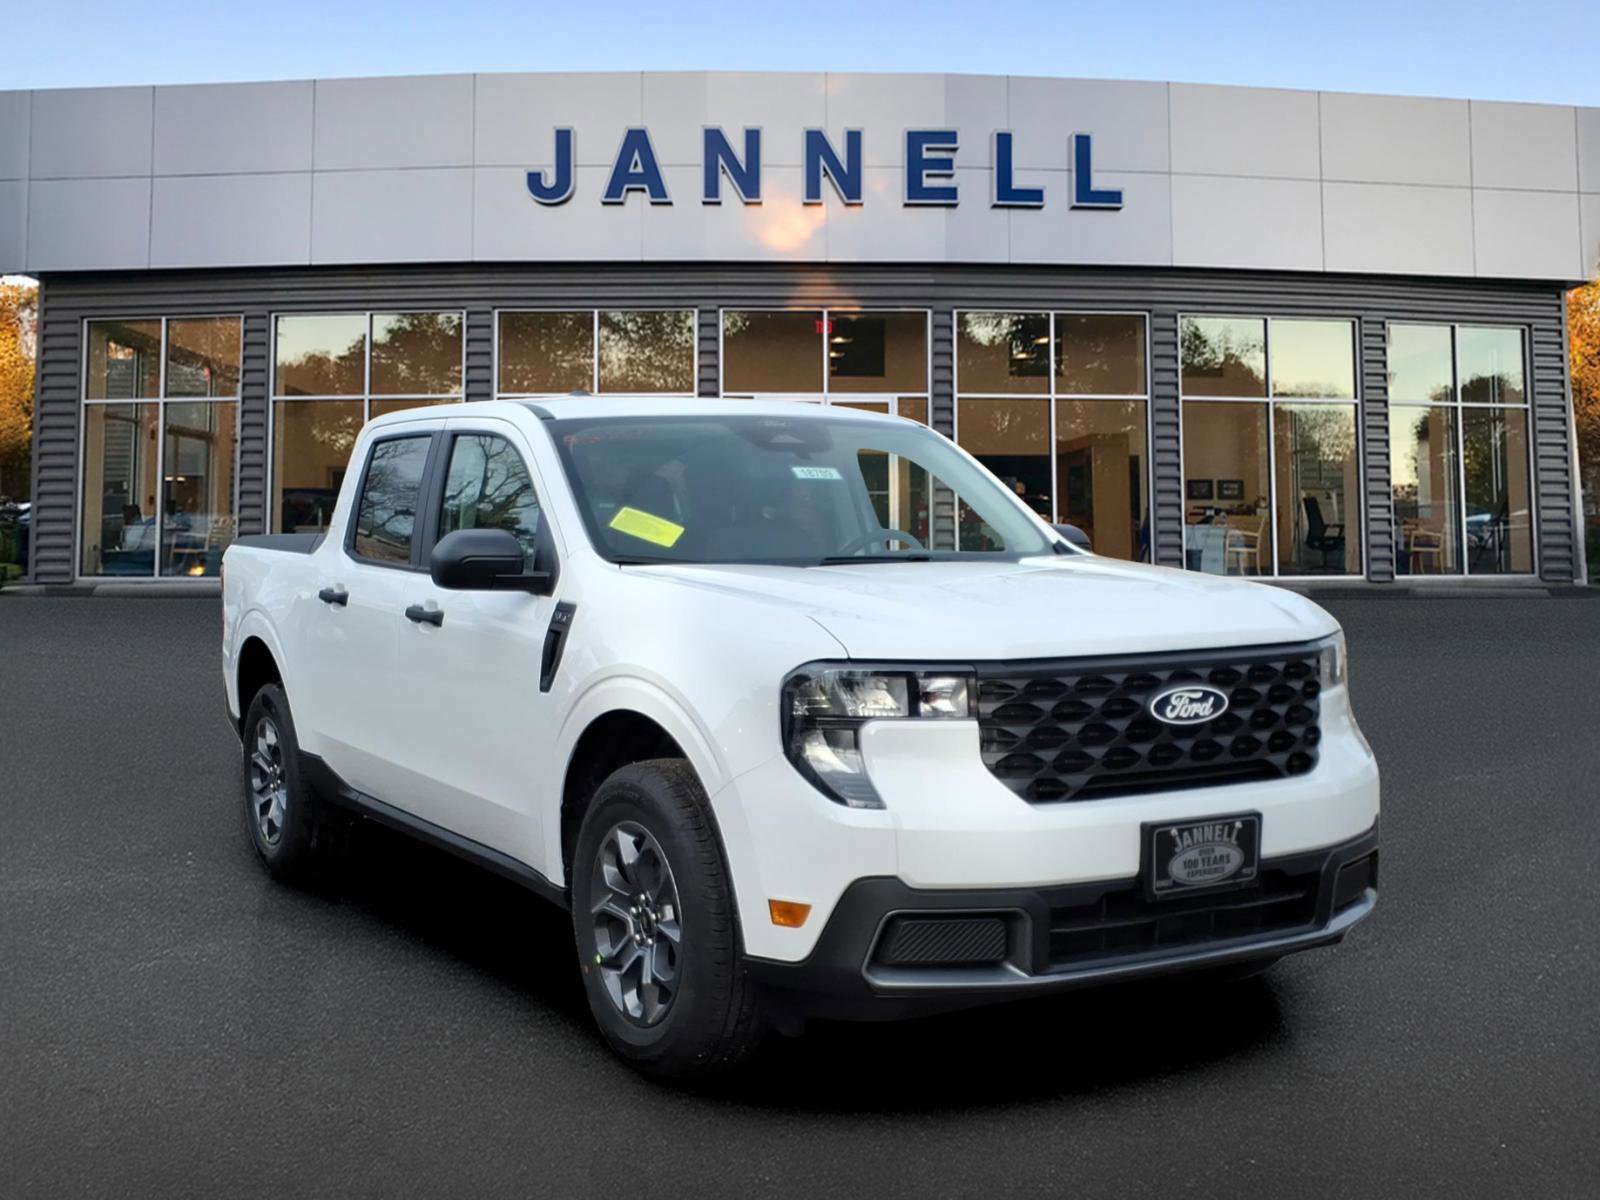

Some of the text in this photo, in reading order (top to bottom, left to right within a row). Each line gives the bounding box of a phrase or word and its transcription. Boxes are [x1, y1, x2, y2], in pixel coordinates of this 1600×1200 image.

[526, 126, 1125, 209] JANNELL
[1166, 692, 1214, 718] Ford
[1173, 824, 1241, 853] JANNELL
[1183, 853, 1231, 870] 100 YEARS
